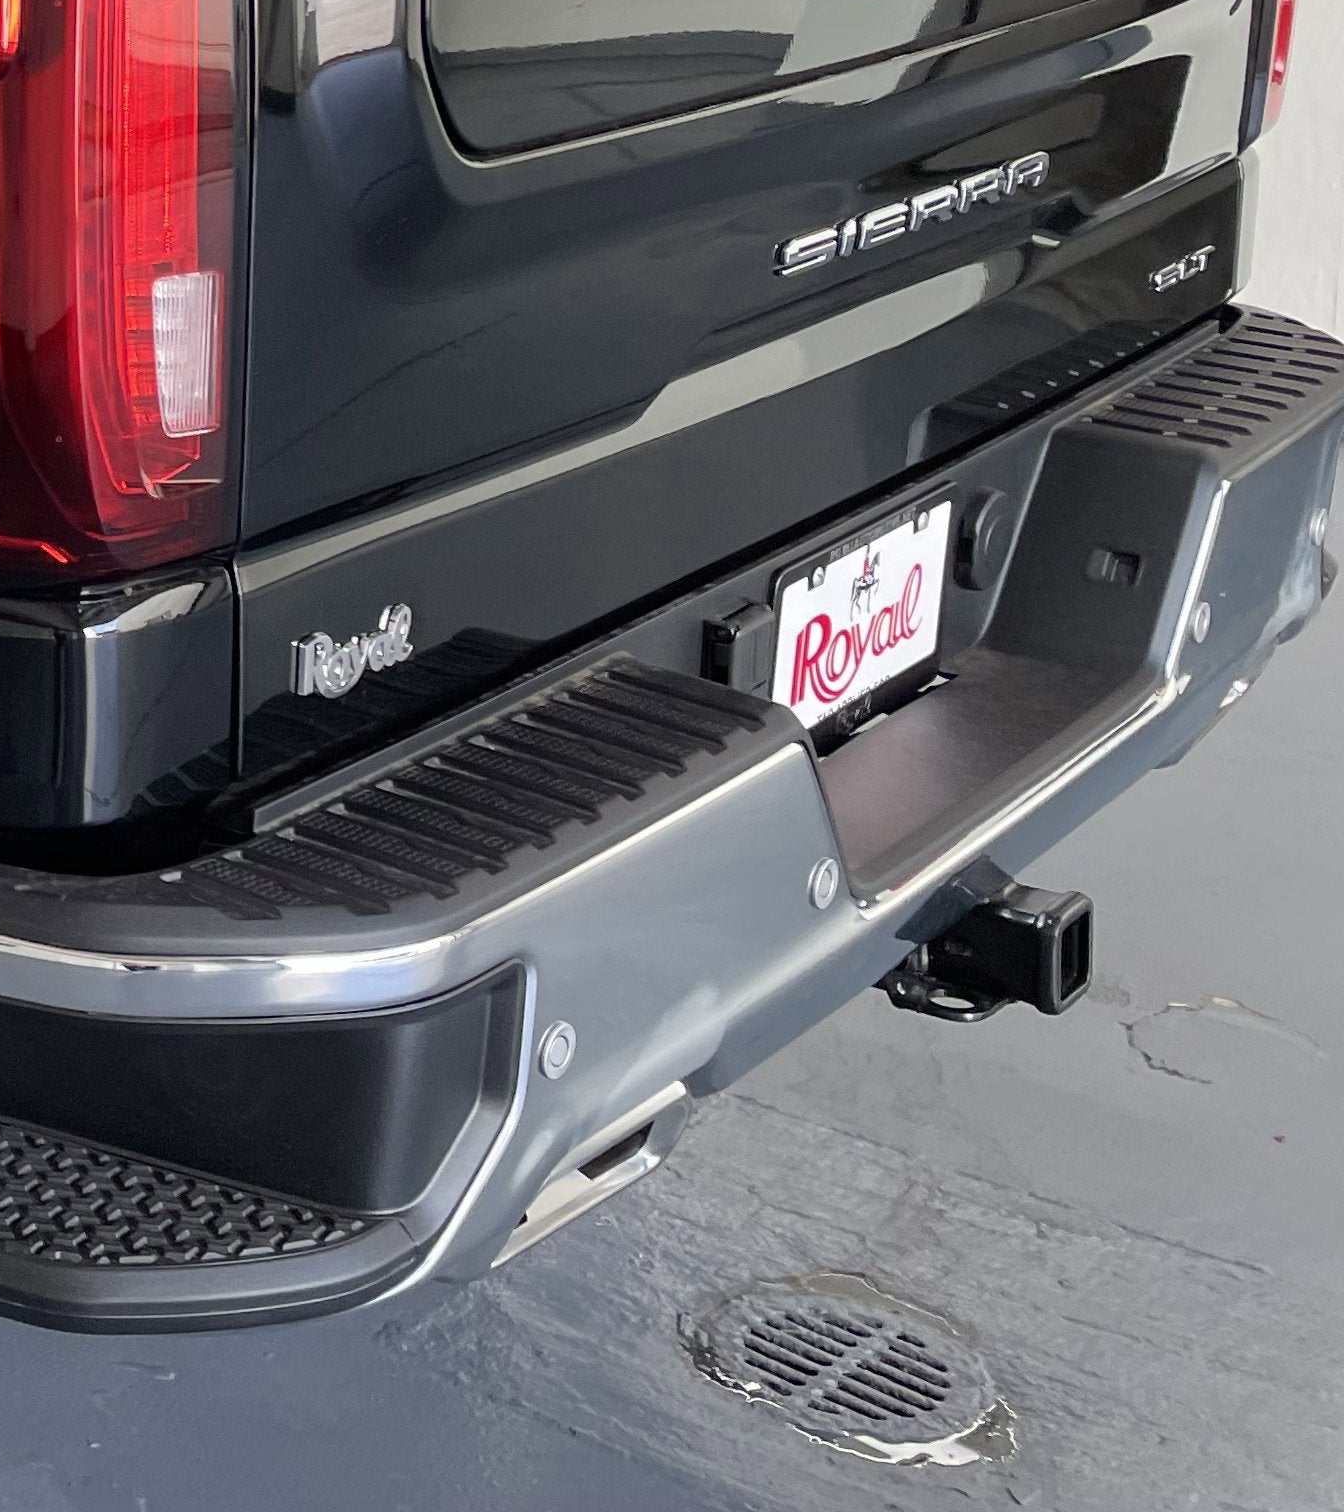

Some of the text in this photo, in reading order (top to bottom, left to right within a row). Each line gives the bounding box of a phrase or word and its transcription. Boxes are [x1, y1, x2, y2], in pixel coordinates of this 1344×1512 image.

[773, 151, 1051, 277] SIERRA
[1150, 245, 1216, 291] SLT
[290, 602, 414, 699] Royal
[790, 563, 923, 707] Royal
